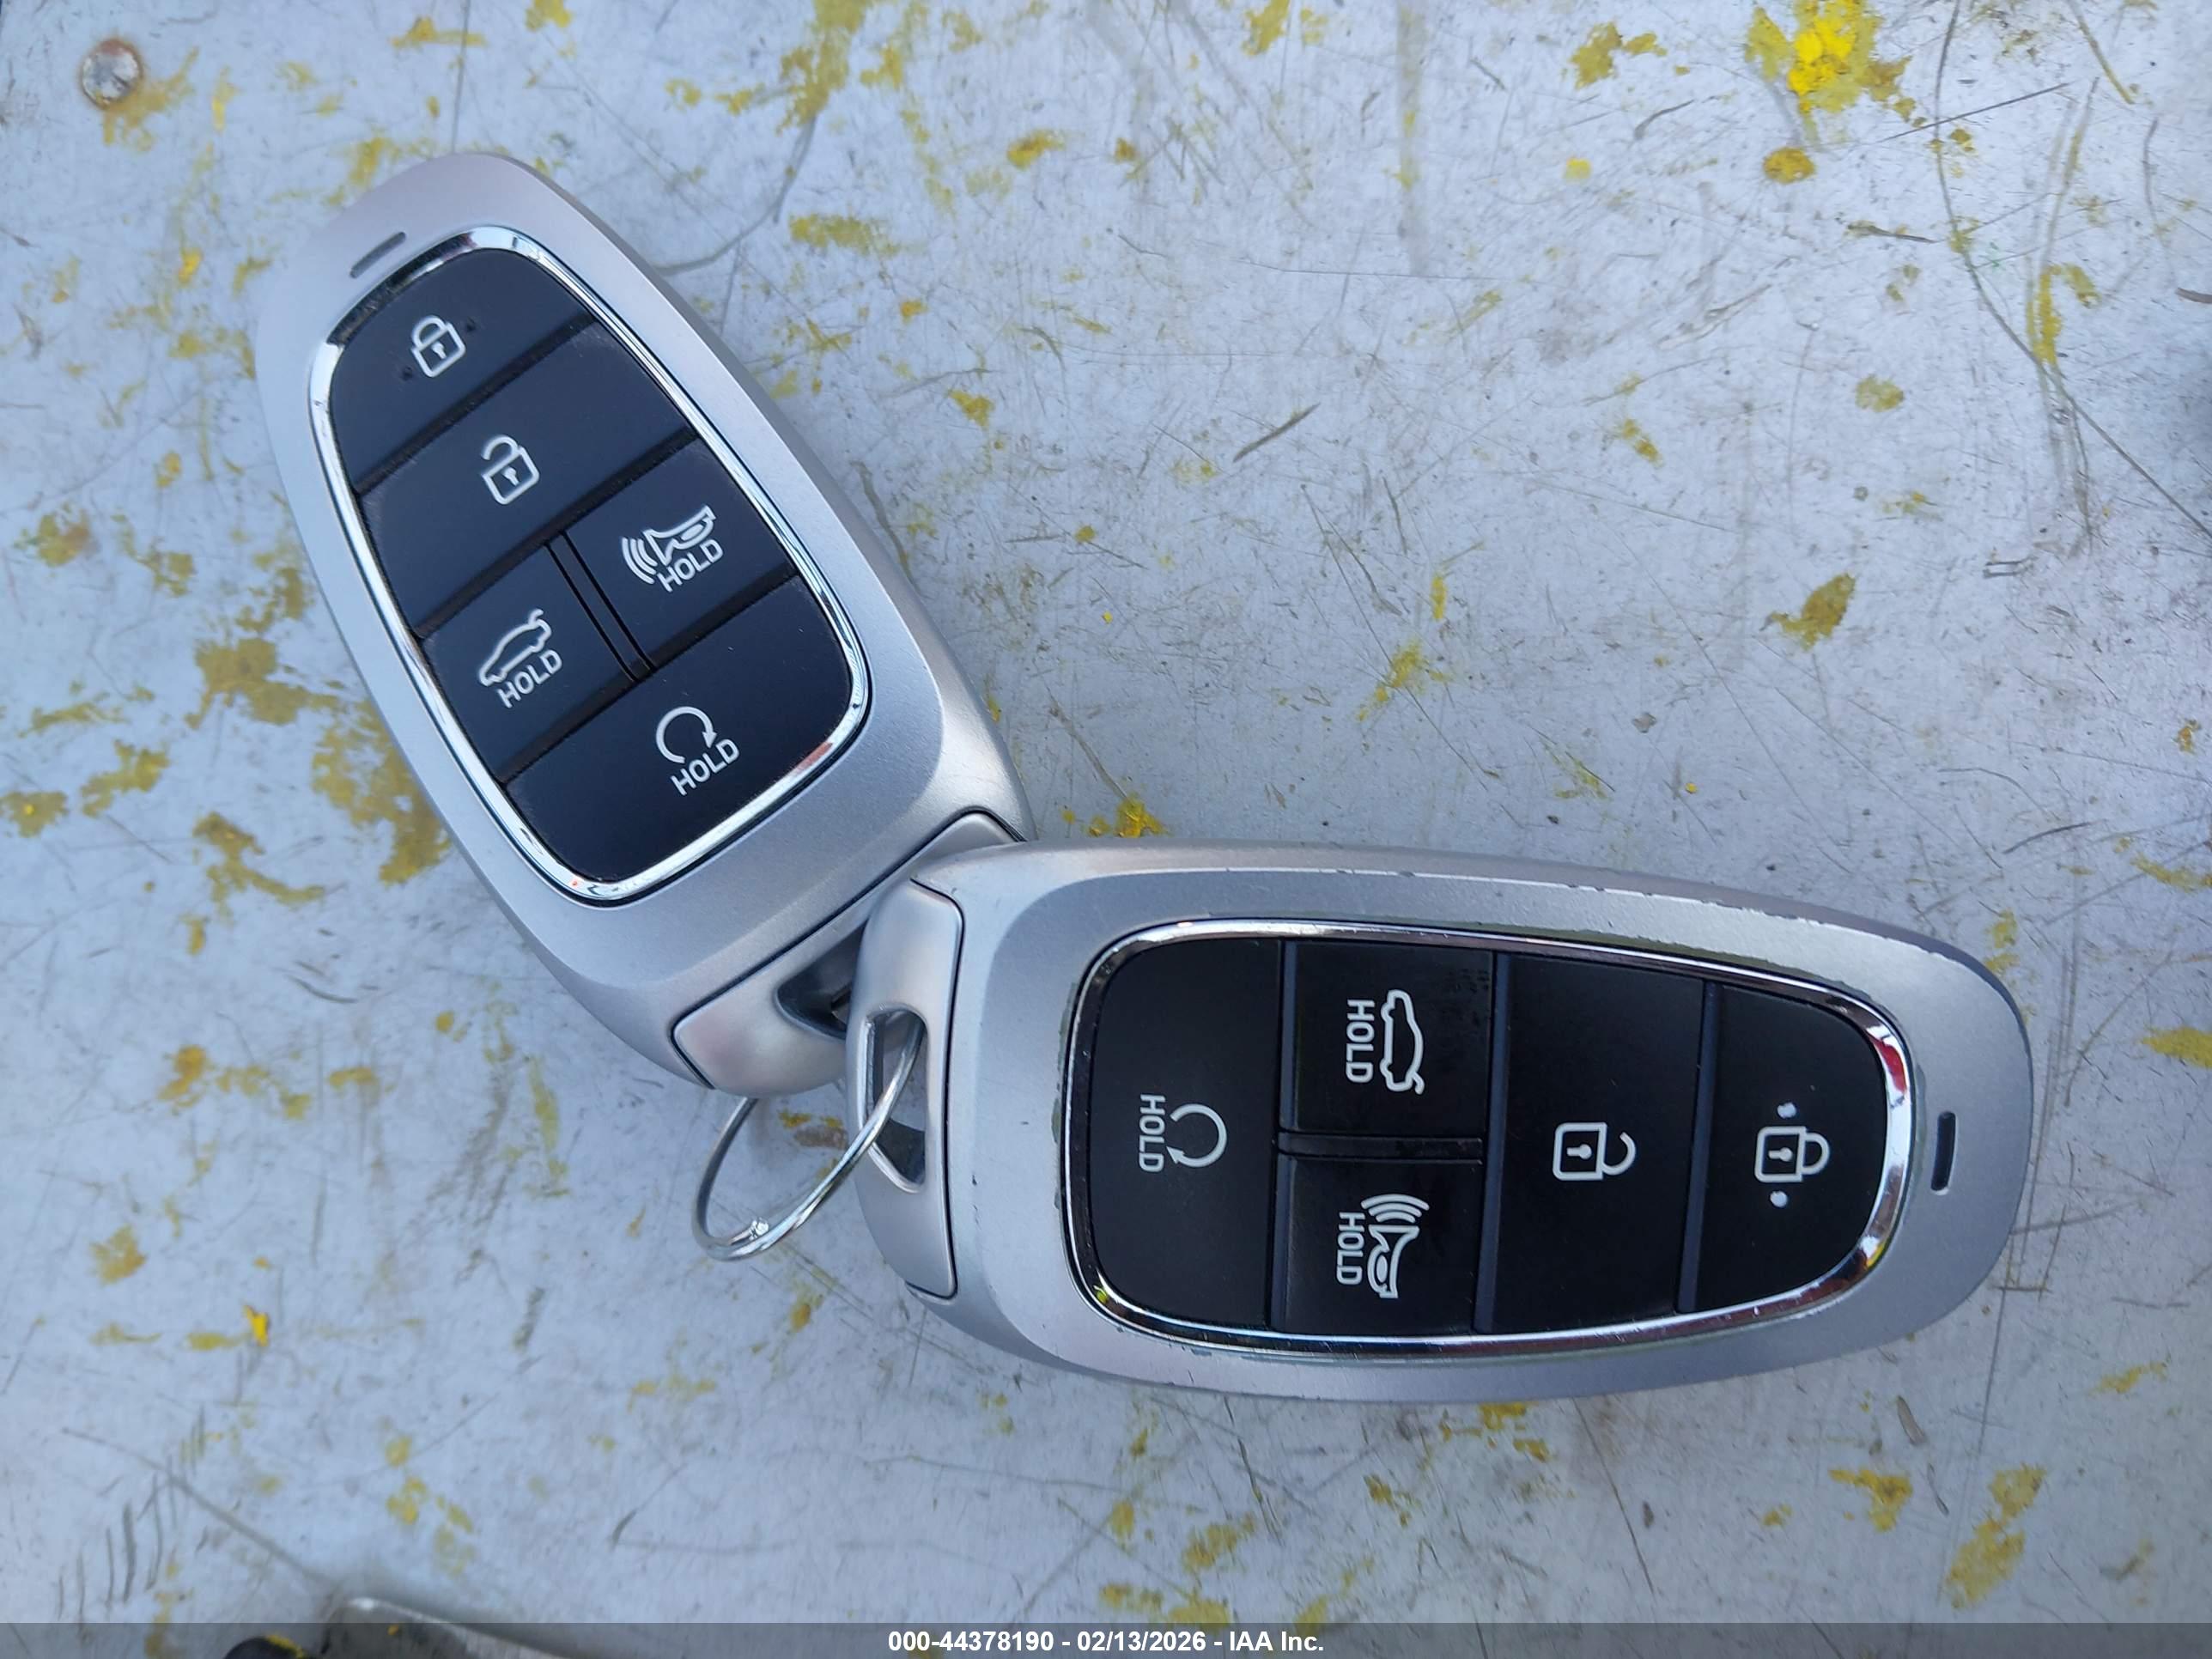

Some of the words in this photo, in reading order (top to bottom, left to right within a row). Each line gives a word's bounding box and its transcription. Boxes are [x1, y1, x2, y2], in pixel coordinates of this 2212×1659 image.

[657, 539, 723, 592] HOLD
[497, 649, 562, 708] HOLD
[671, 738, 739, 796] HOLD
[1346, 999, 1375, 1083] HOLD
[1139, 1093, 1166, 1172] HOLD
[1336, 1212, 1365, 1285] HOLD
